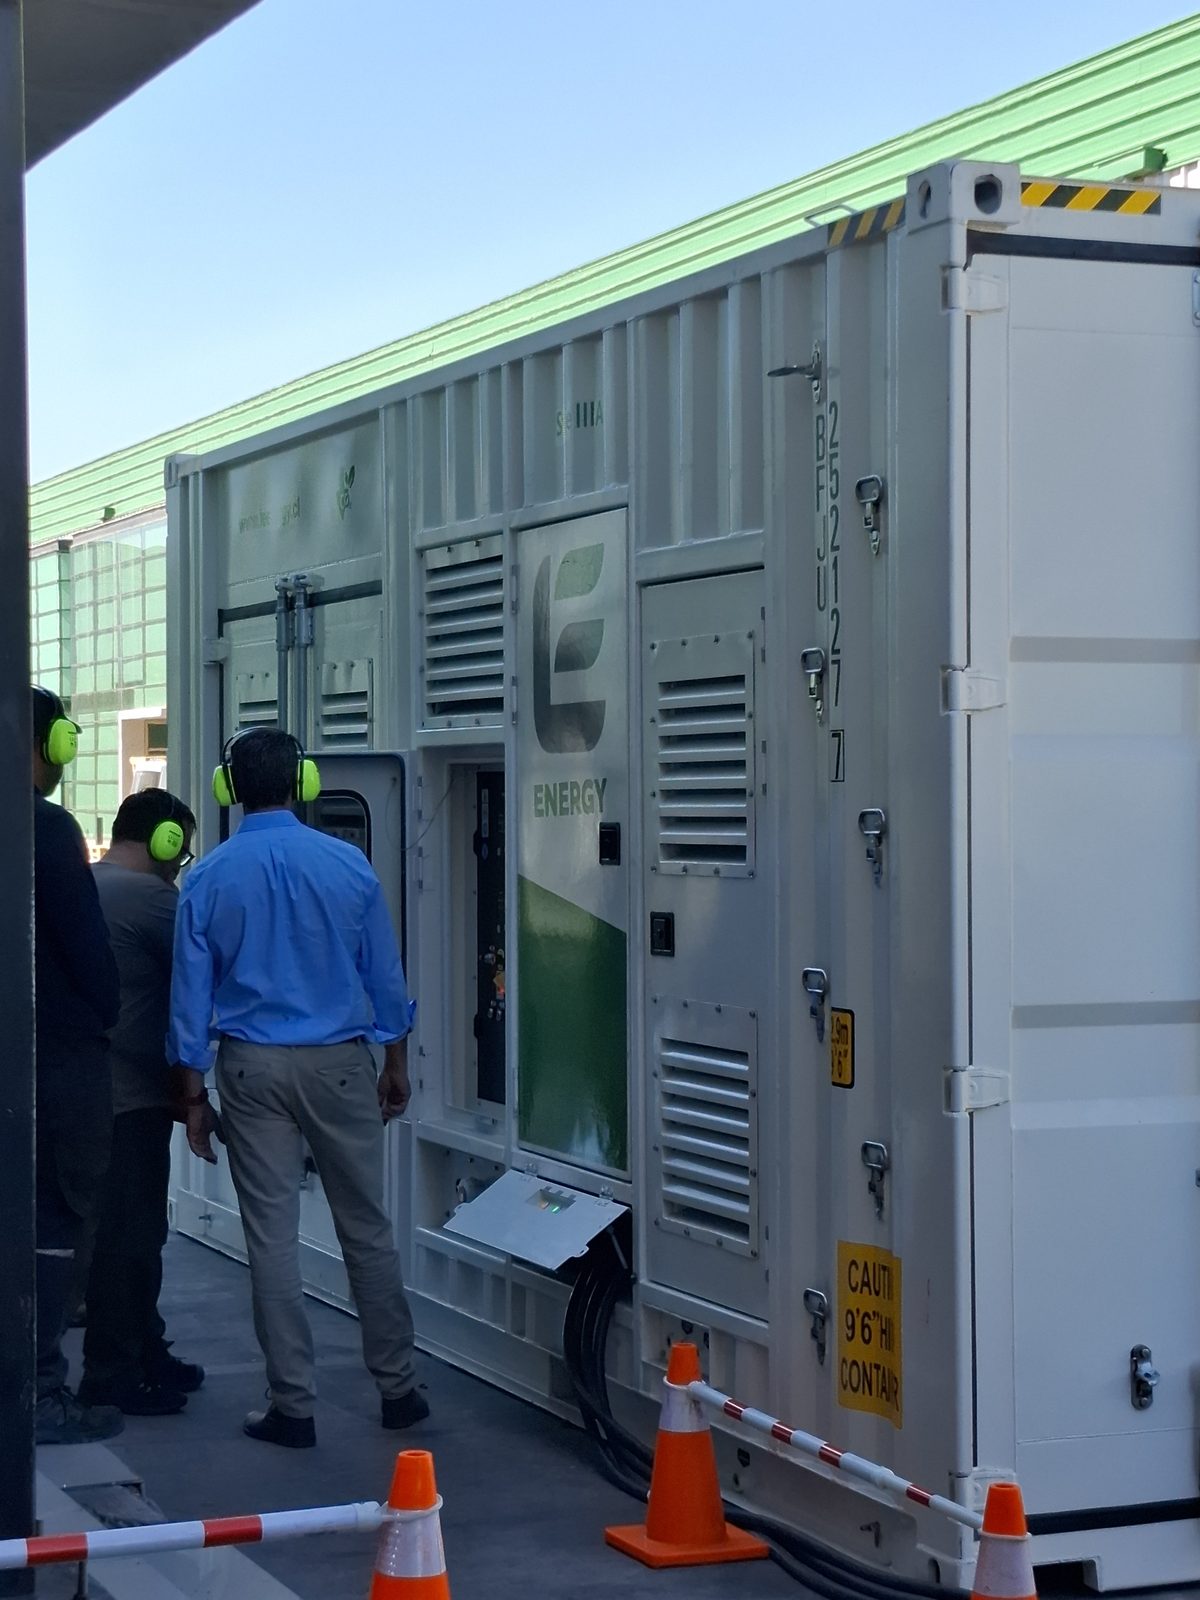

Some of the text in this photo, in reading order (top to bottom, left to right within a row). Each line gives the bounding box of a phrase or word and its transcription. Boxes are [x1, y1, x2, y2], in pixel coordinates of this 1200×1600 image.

[815, 414, 827, 613] BFJU
[829, 400, 841, 708] 252127
[533, 777, 608, 818] ENERGY
[848, 1259, 893, 1301] CAUTI
